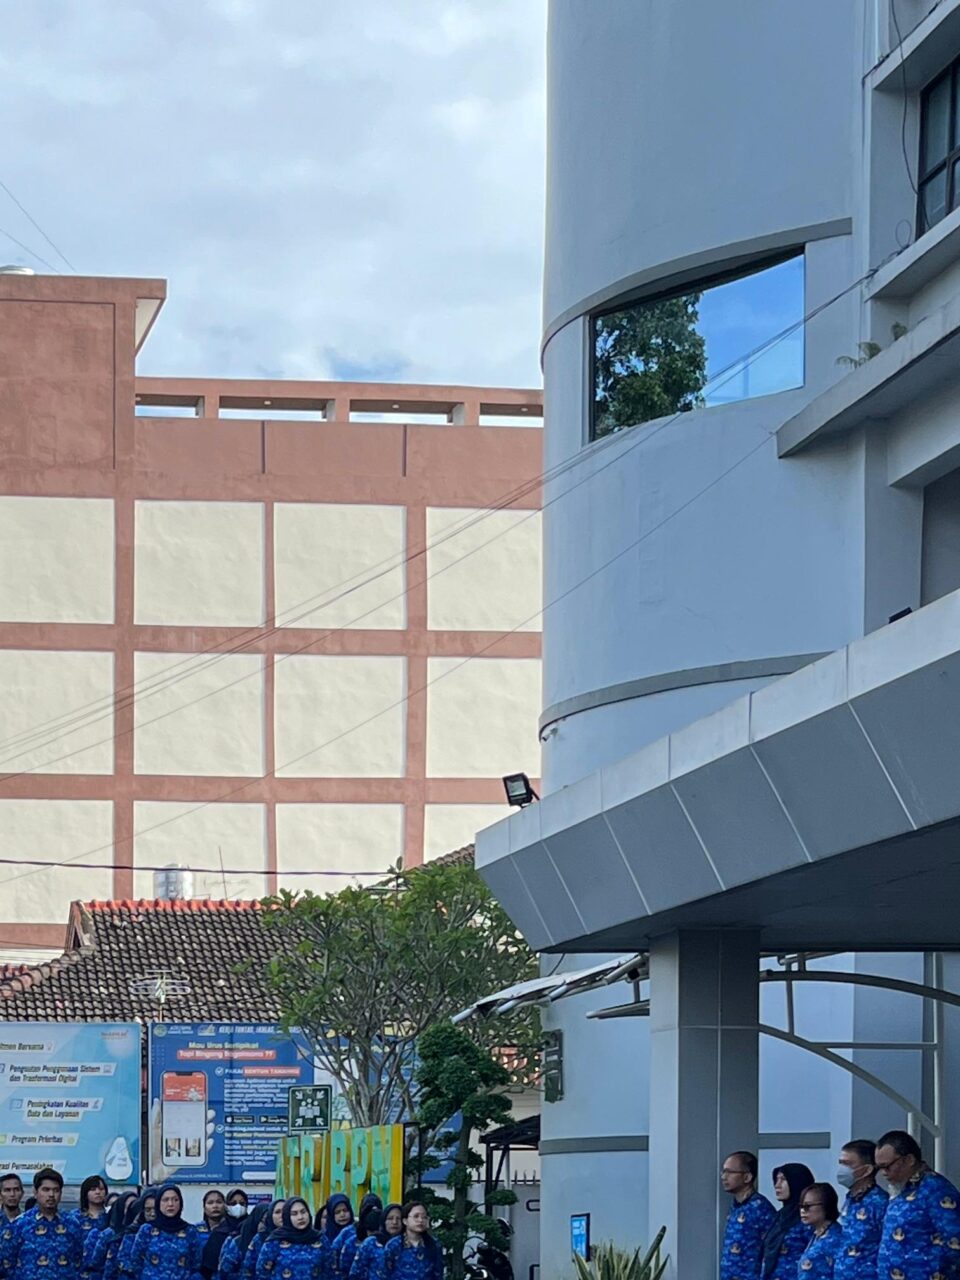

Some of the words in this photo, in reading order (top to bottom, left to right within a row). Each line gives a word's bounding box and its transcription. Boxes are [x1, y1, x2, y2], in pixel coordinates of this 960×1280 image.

[58, 1075, 78, 1084] Digital
[27, 1101, 63, 1109] Peningkatan
[27, 1110, 41, 1118] Data
[42, 1110, 54, 1118] dan
[54, 1110, 79, 1119] Layanan
[11, 1135, 36, 1145] Program
[38, 1135, 63, 1143] Prioritas
